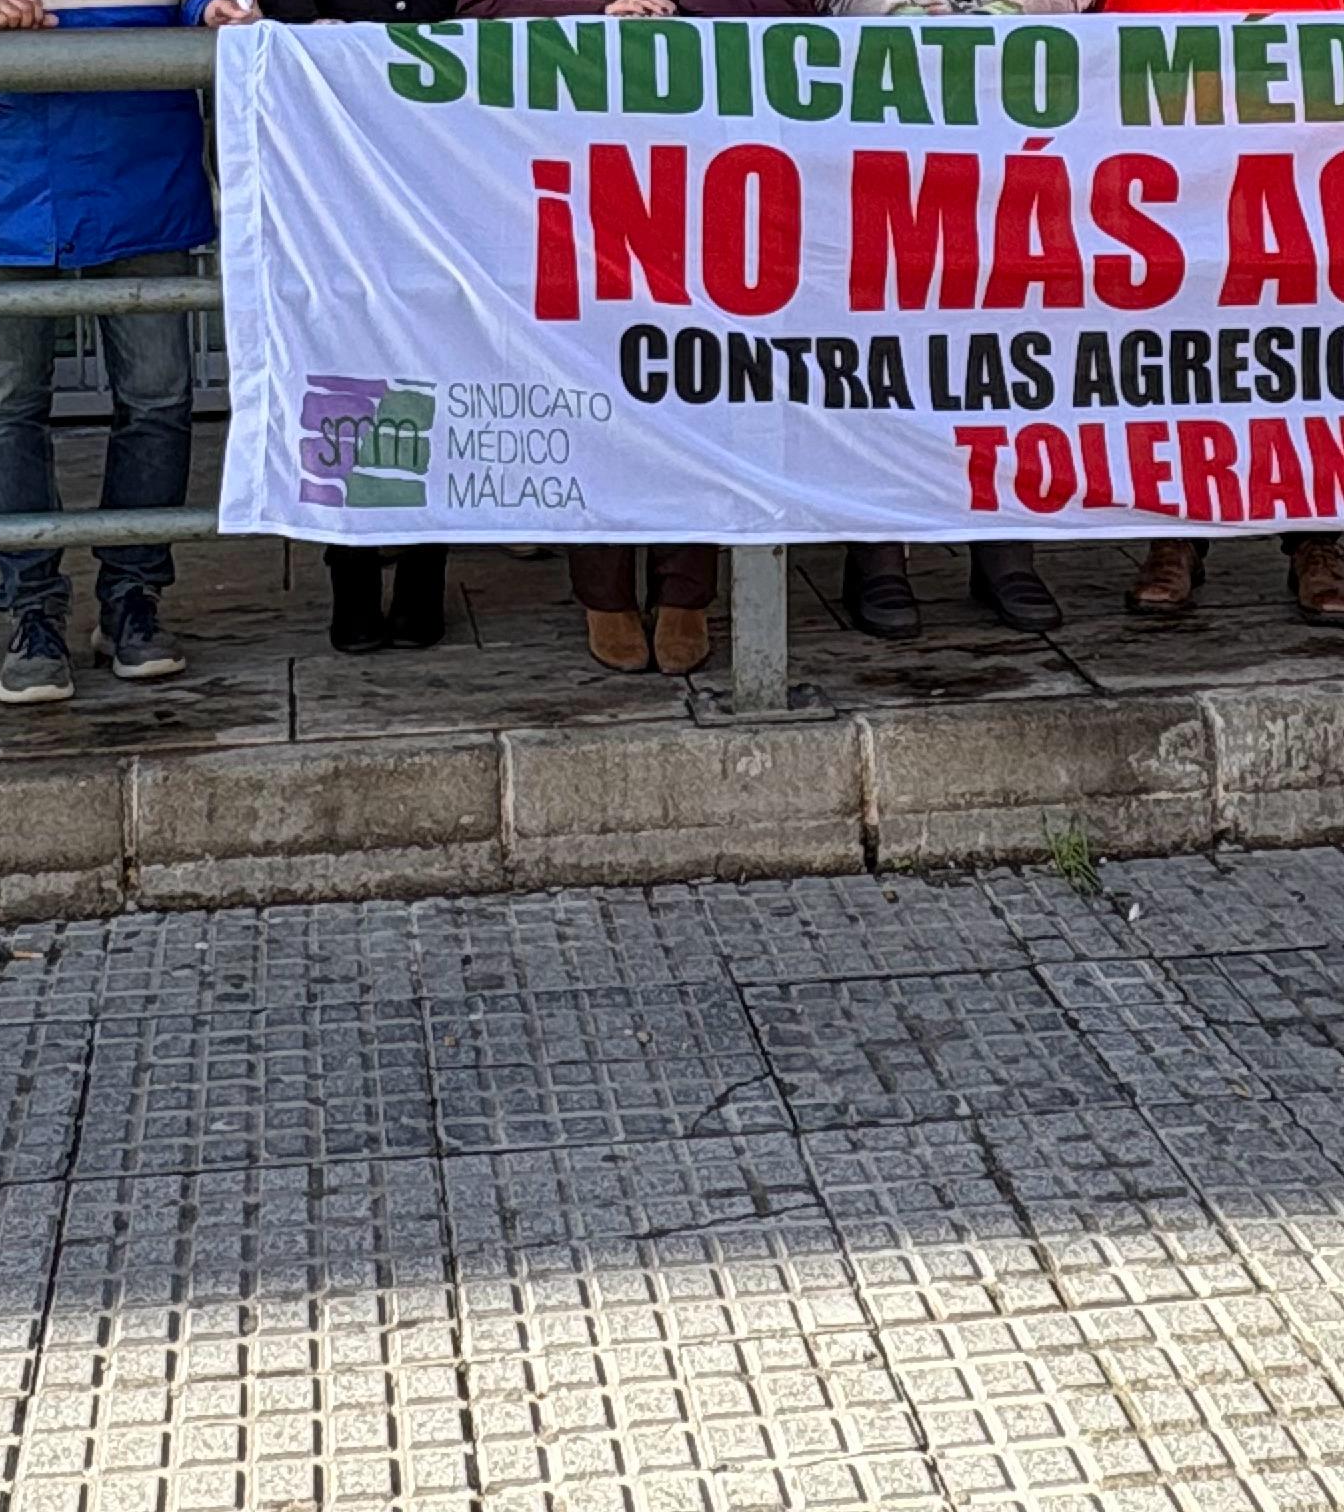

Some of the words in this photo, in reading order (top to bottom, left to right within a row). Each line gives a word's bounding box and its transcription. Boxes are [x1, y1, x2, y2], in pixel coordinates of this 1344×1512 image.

[387, 19, 1079, 126] SINDICATO
[532, 144, 802, 320] ¡NO
[848, 137, 1186, 312] MÁS
[621, 324, 916, 410] CONTRA
[929, 331, 1054, 410] LAS
[447, 381, 612, 422] SINDICATO
[447, 422, 571, 465] MÉDICO
[447, 467, 587, 510] MÁLAGA
